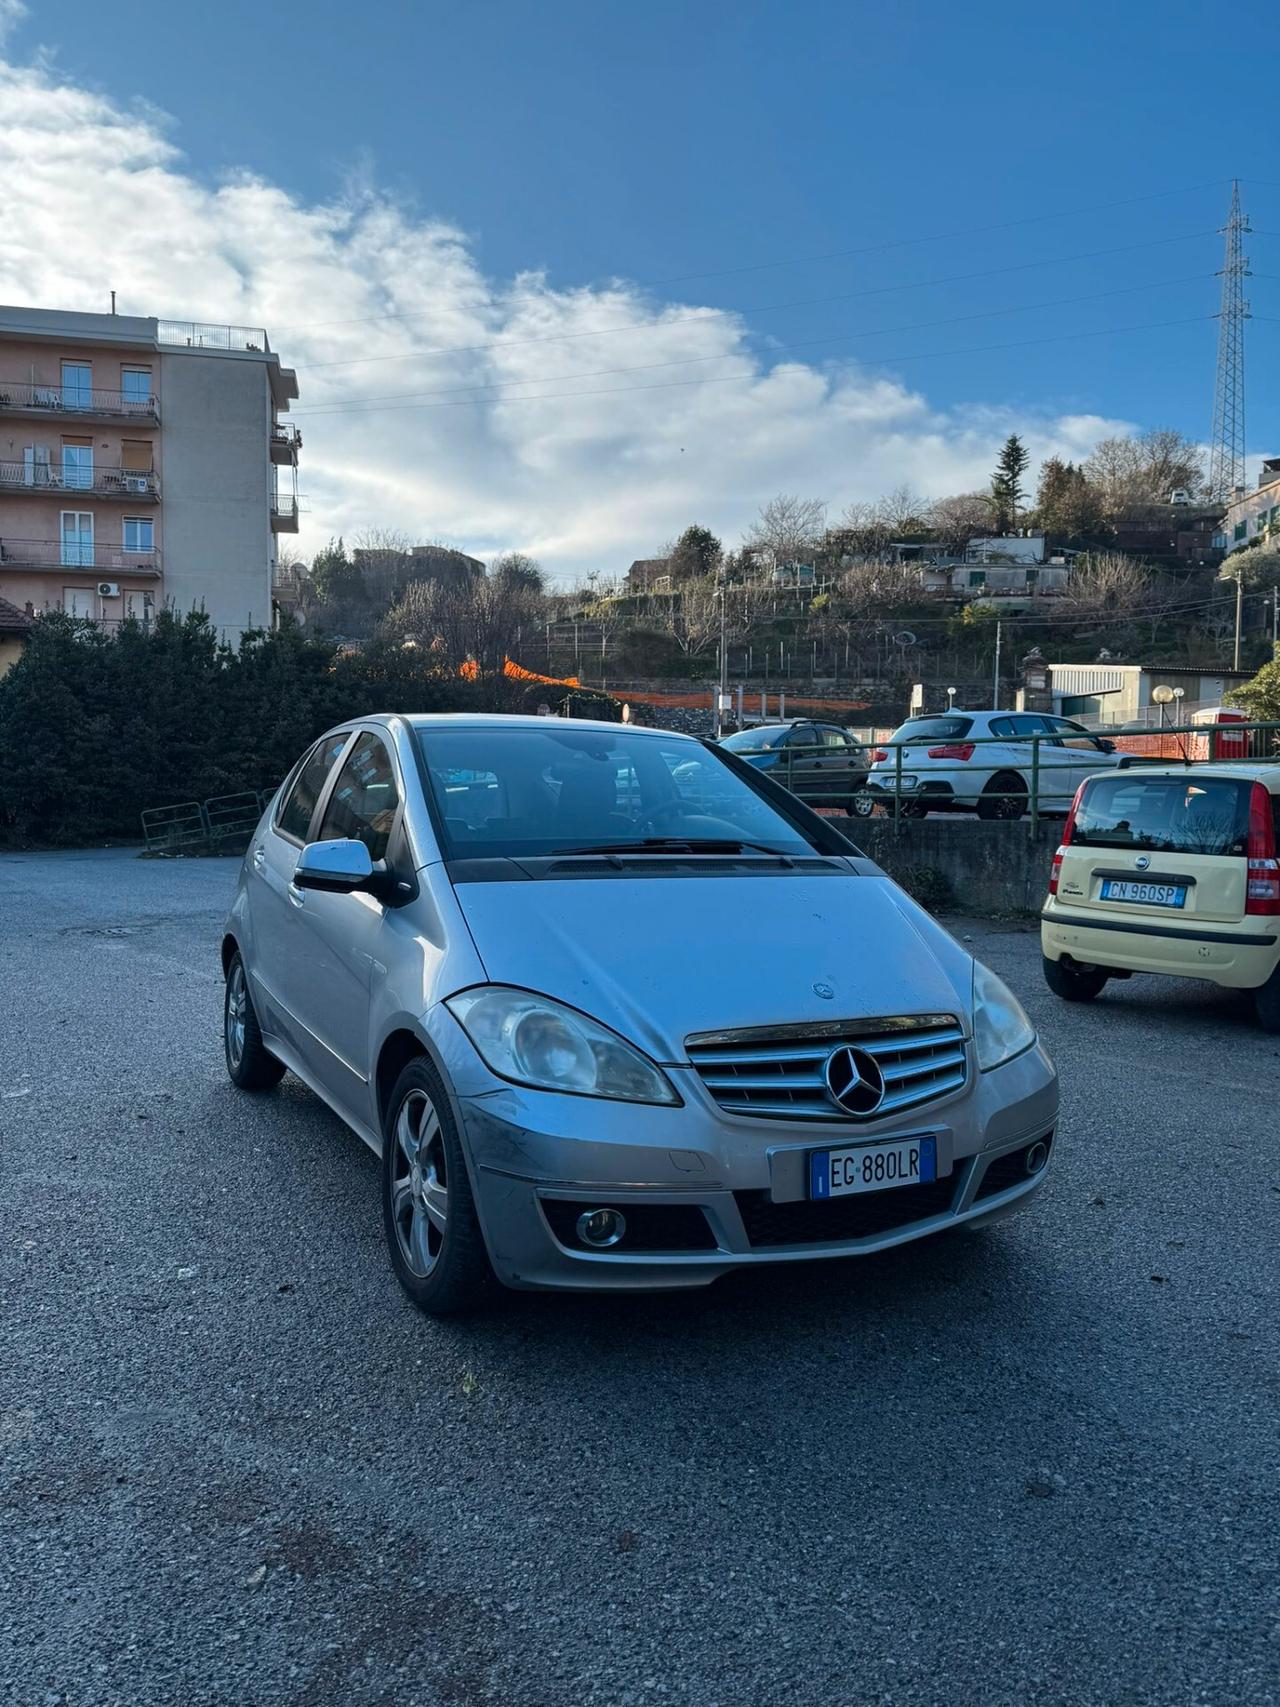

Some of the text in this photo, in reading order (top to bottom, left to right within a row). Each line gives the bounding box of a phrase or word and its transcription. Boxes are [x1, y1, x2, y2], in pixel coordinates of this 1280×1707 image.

[1110, 882, 1128, 898] CN
[1130, 884, 1175, 902] 960SP
[831, 1156, 855, 1188] EG
[862, 1149, 919, 1183] 880LR
